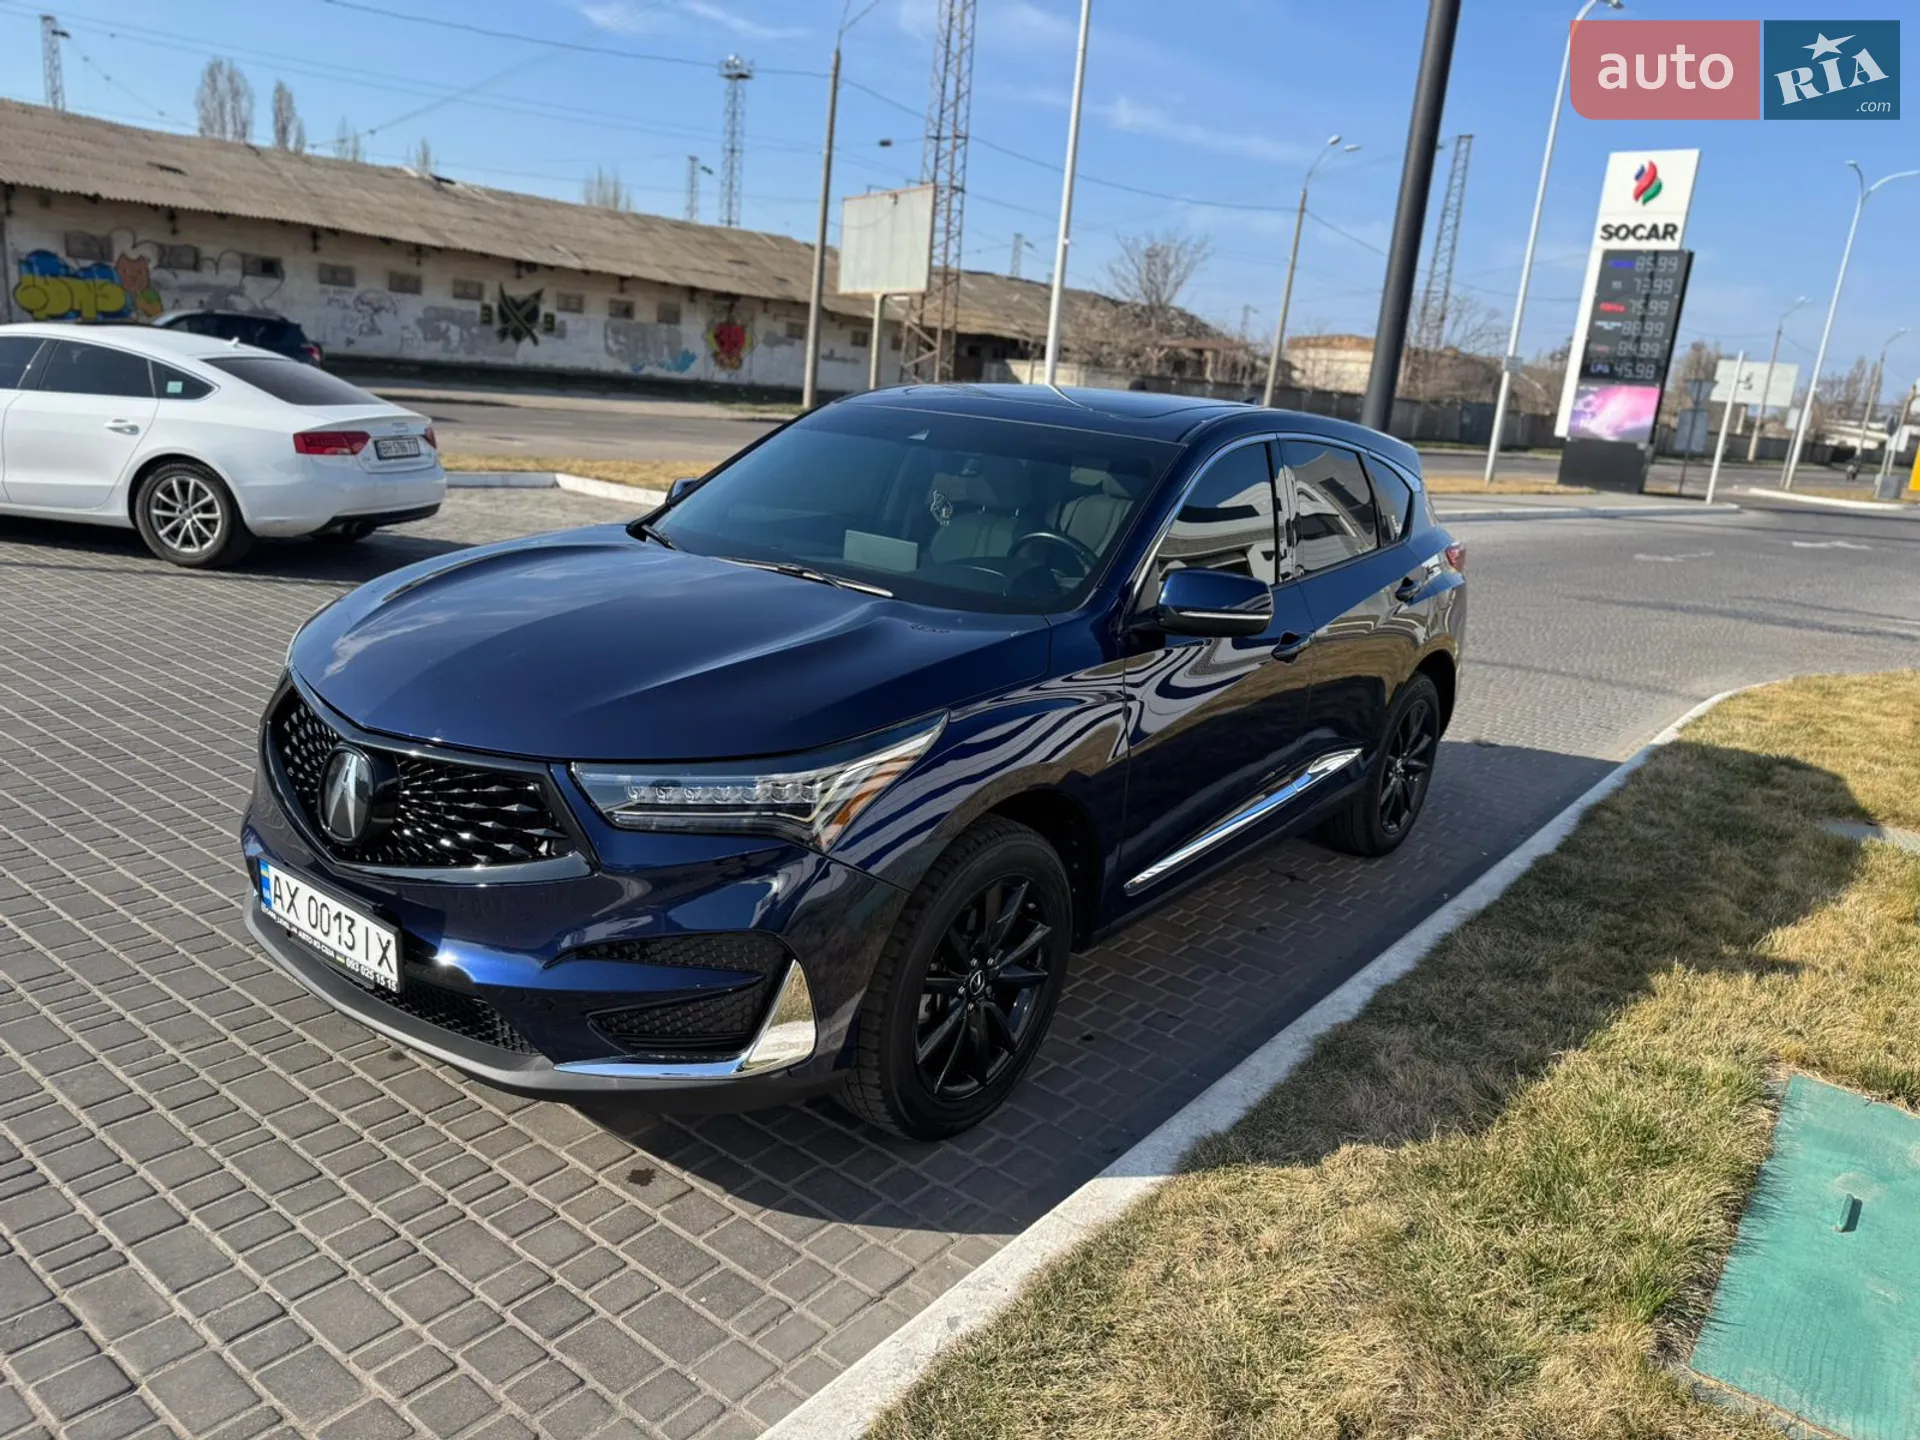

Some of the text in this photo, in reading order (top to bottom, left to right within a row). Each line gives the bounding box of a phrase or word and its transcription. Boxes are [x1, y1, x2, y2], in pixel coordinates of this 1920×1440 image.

[1600, 223, 1679, 241] SOCAR
[273, 874, 300, 921] AX
[308, 894, 356, 952] 0013
[365, 926, 395, 975] IX
